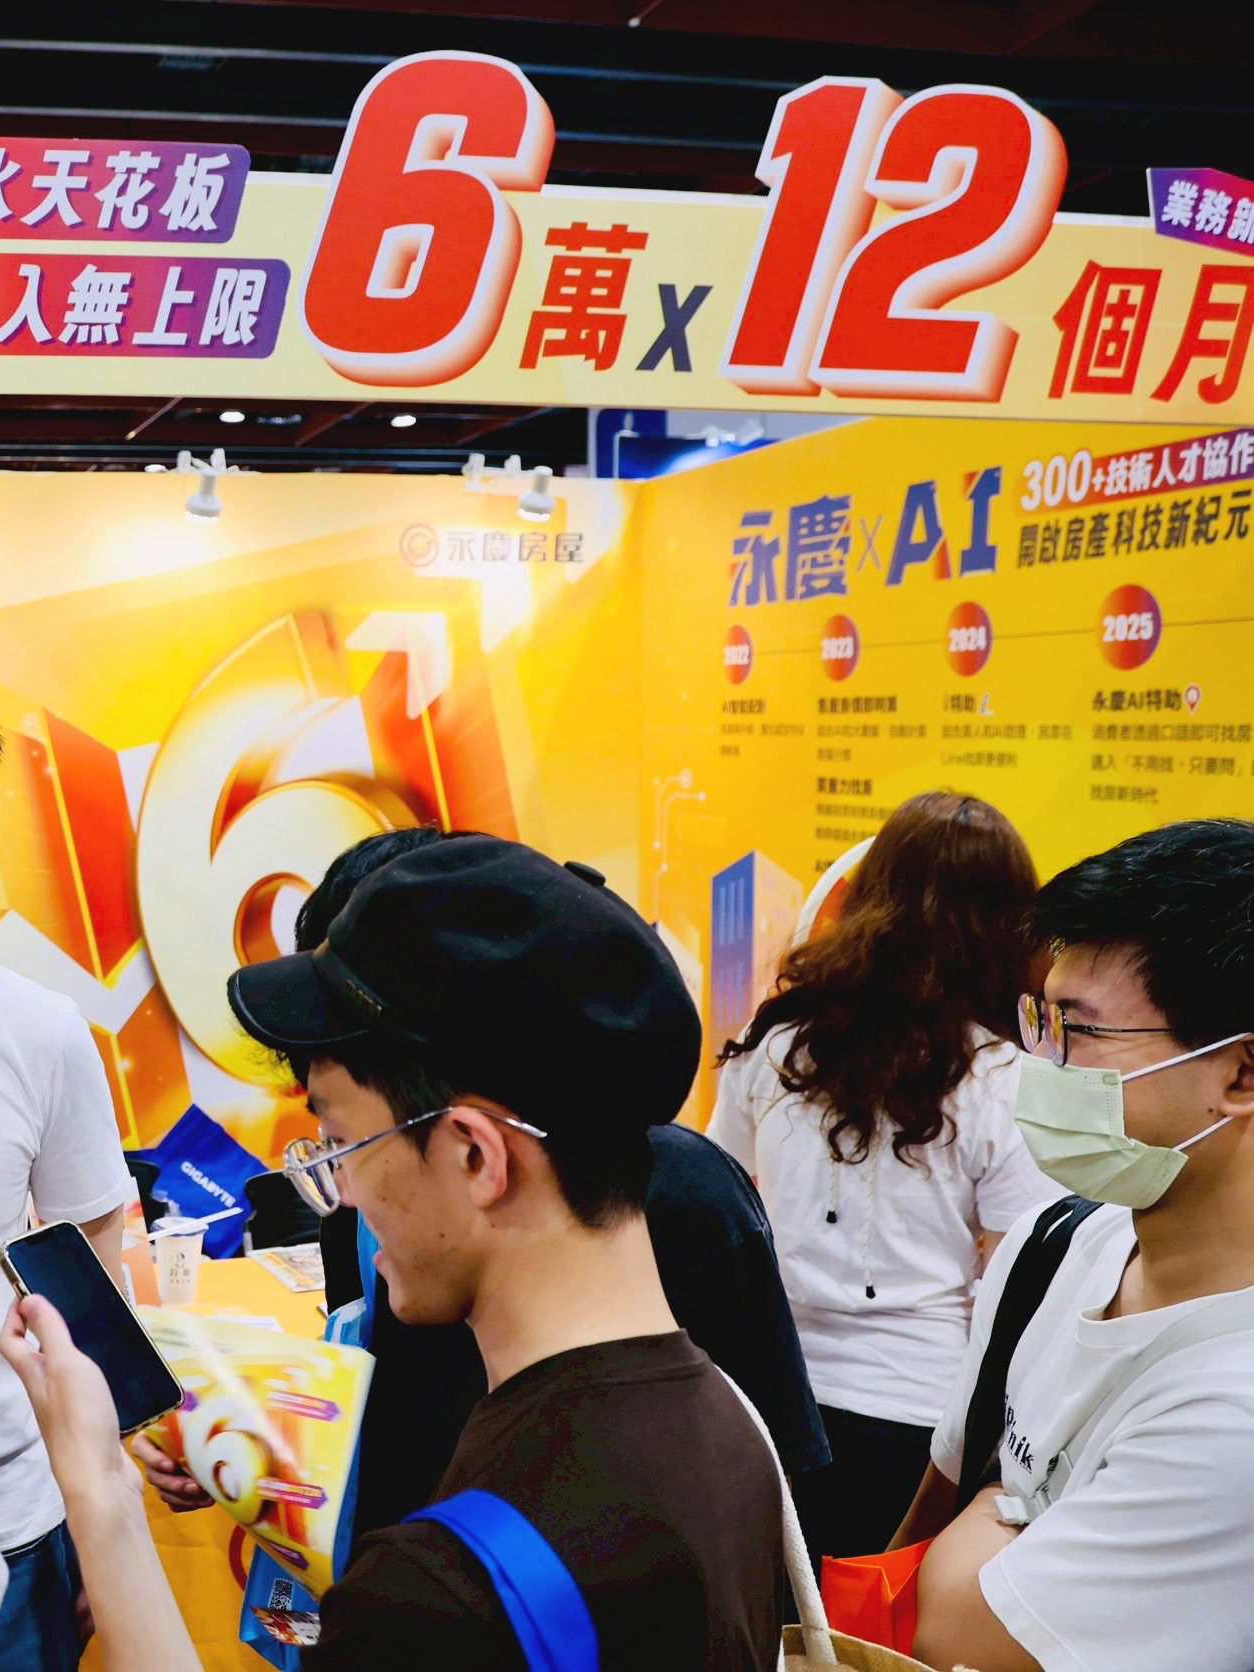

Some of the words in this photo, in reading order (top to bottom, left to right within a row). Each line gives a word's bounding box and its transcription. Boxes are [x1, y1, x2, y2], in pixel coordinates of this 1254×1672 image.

[948, 625, 987, 653] 2024
[1102, 611, 1155, 644] 2025
[180, 1161, 237, 1208] GIGABYTE
